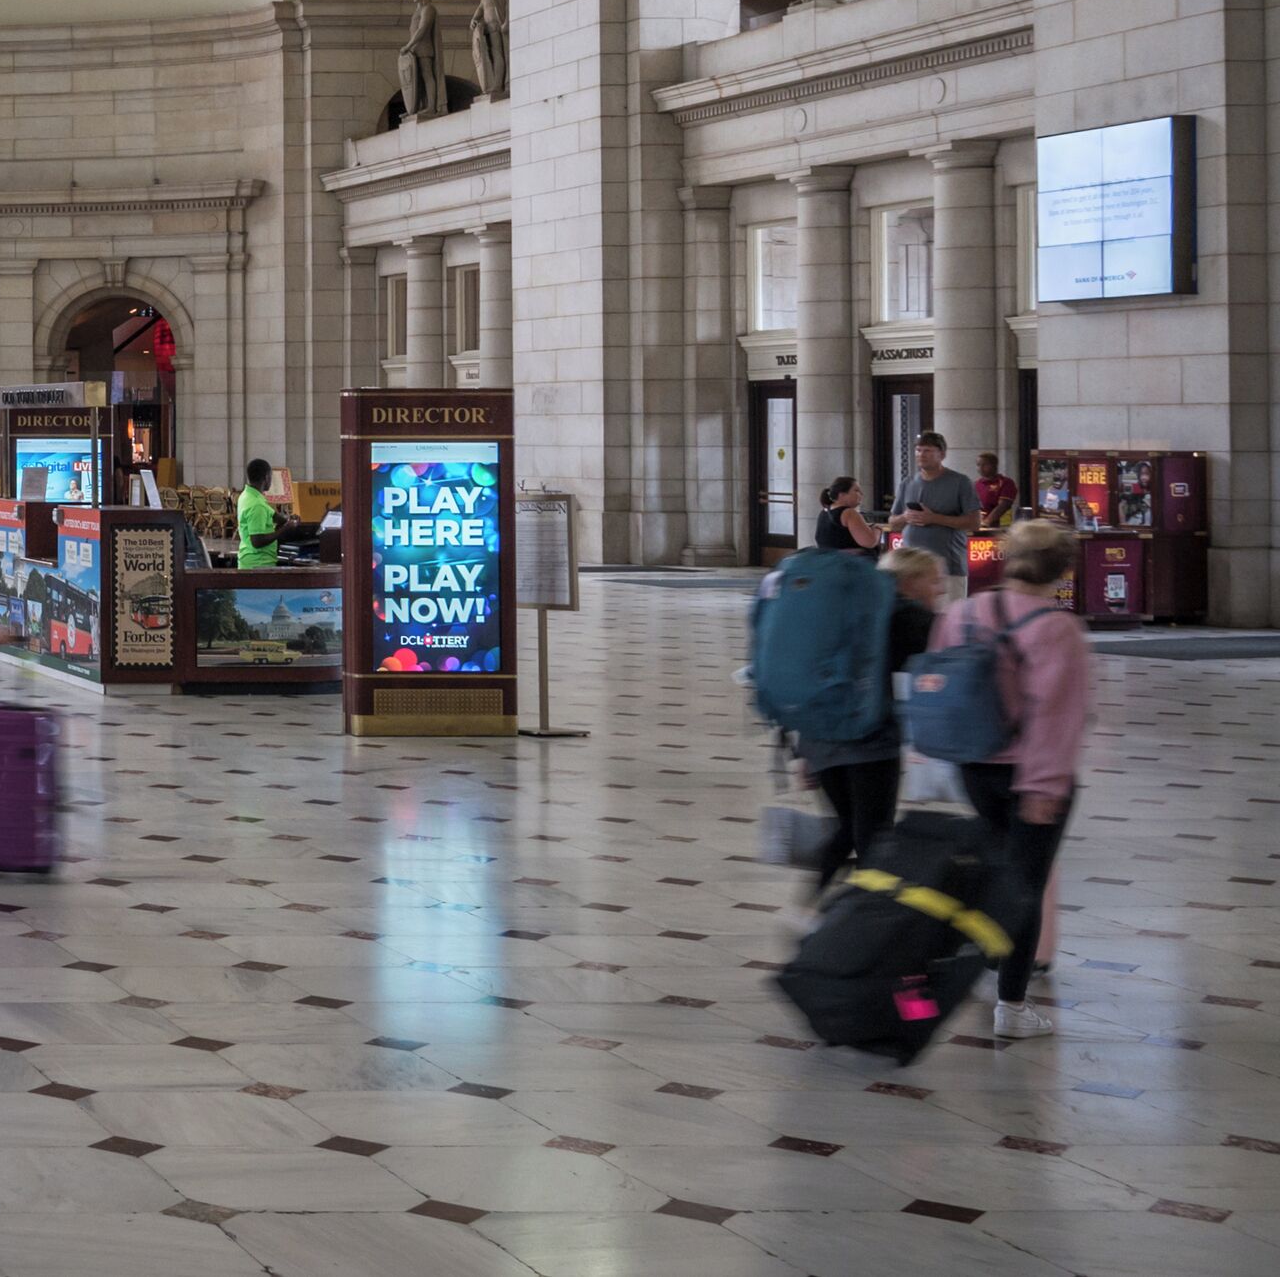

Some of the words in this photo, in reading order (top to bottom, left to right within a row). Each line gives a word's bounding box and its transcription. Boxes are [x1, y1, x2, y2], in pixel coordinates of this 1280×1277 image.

[872, 347, 934, 361] MASSACHUSET
[17, 415, 103, 427] DIRECTOR
[372, 407, 493, 424] DIRECTOR
[1080, 472, 1106, 484] HERE
[309, 484, 340, 496] thun
[384, 487, 483, 514] PLAY
[384, 520, 484, 546] HERE
[970, 551, 1008, 561] EXPLO
[123, 559, 165, 571] World
[384, 564, 484, 592] PLAY
[385, 597, 485, 623] NOW!
[123, 631, 165, 642] Forbes
